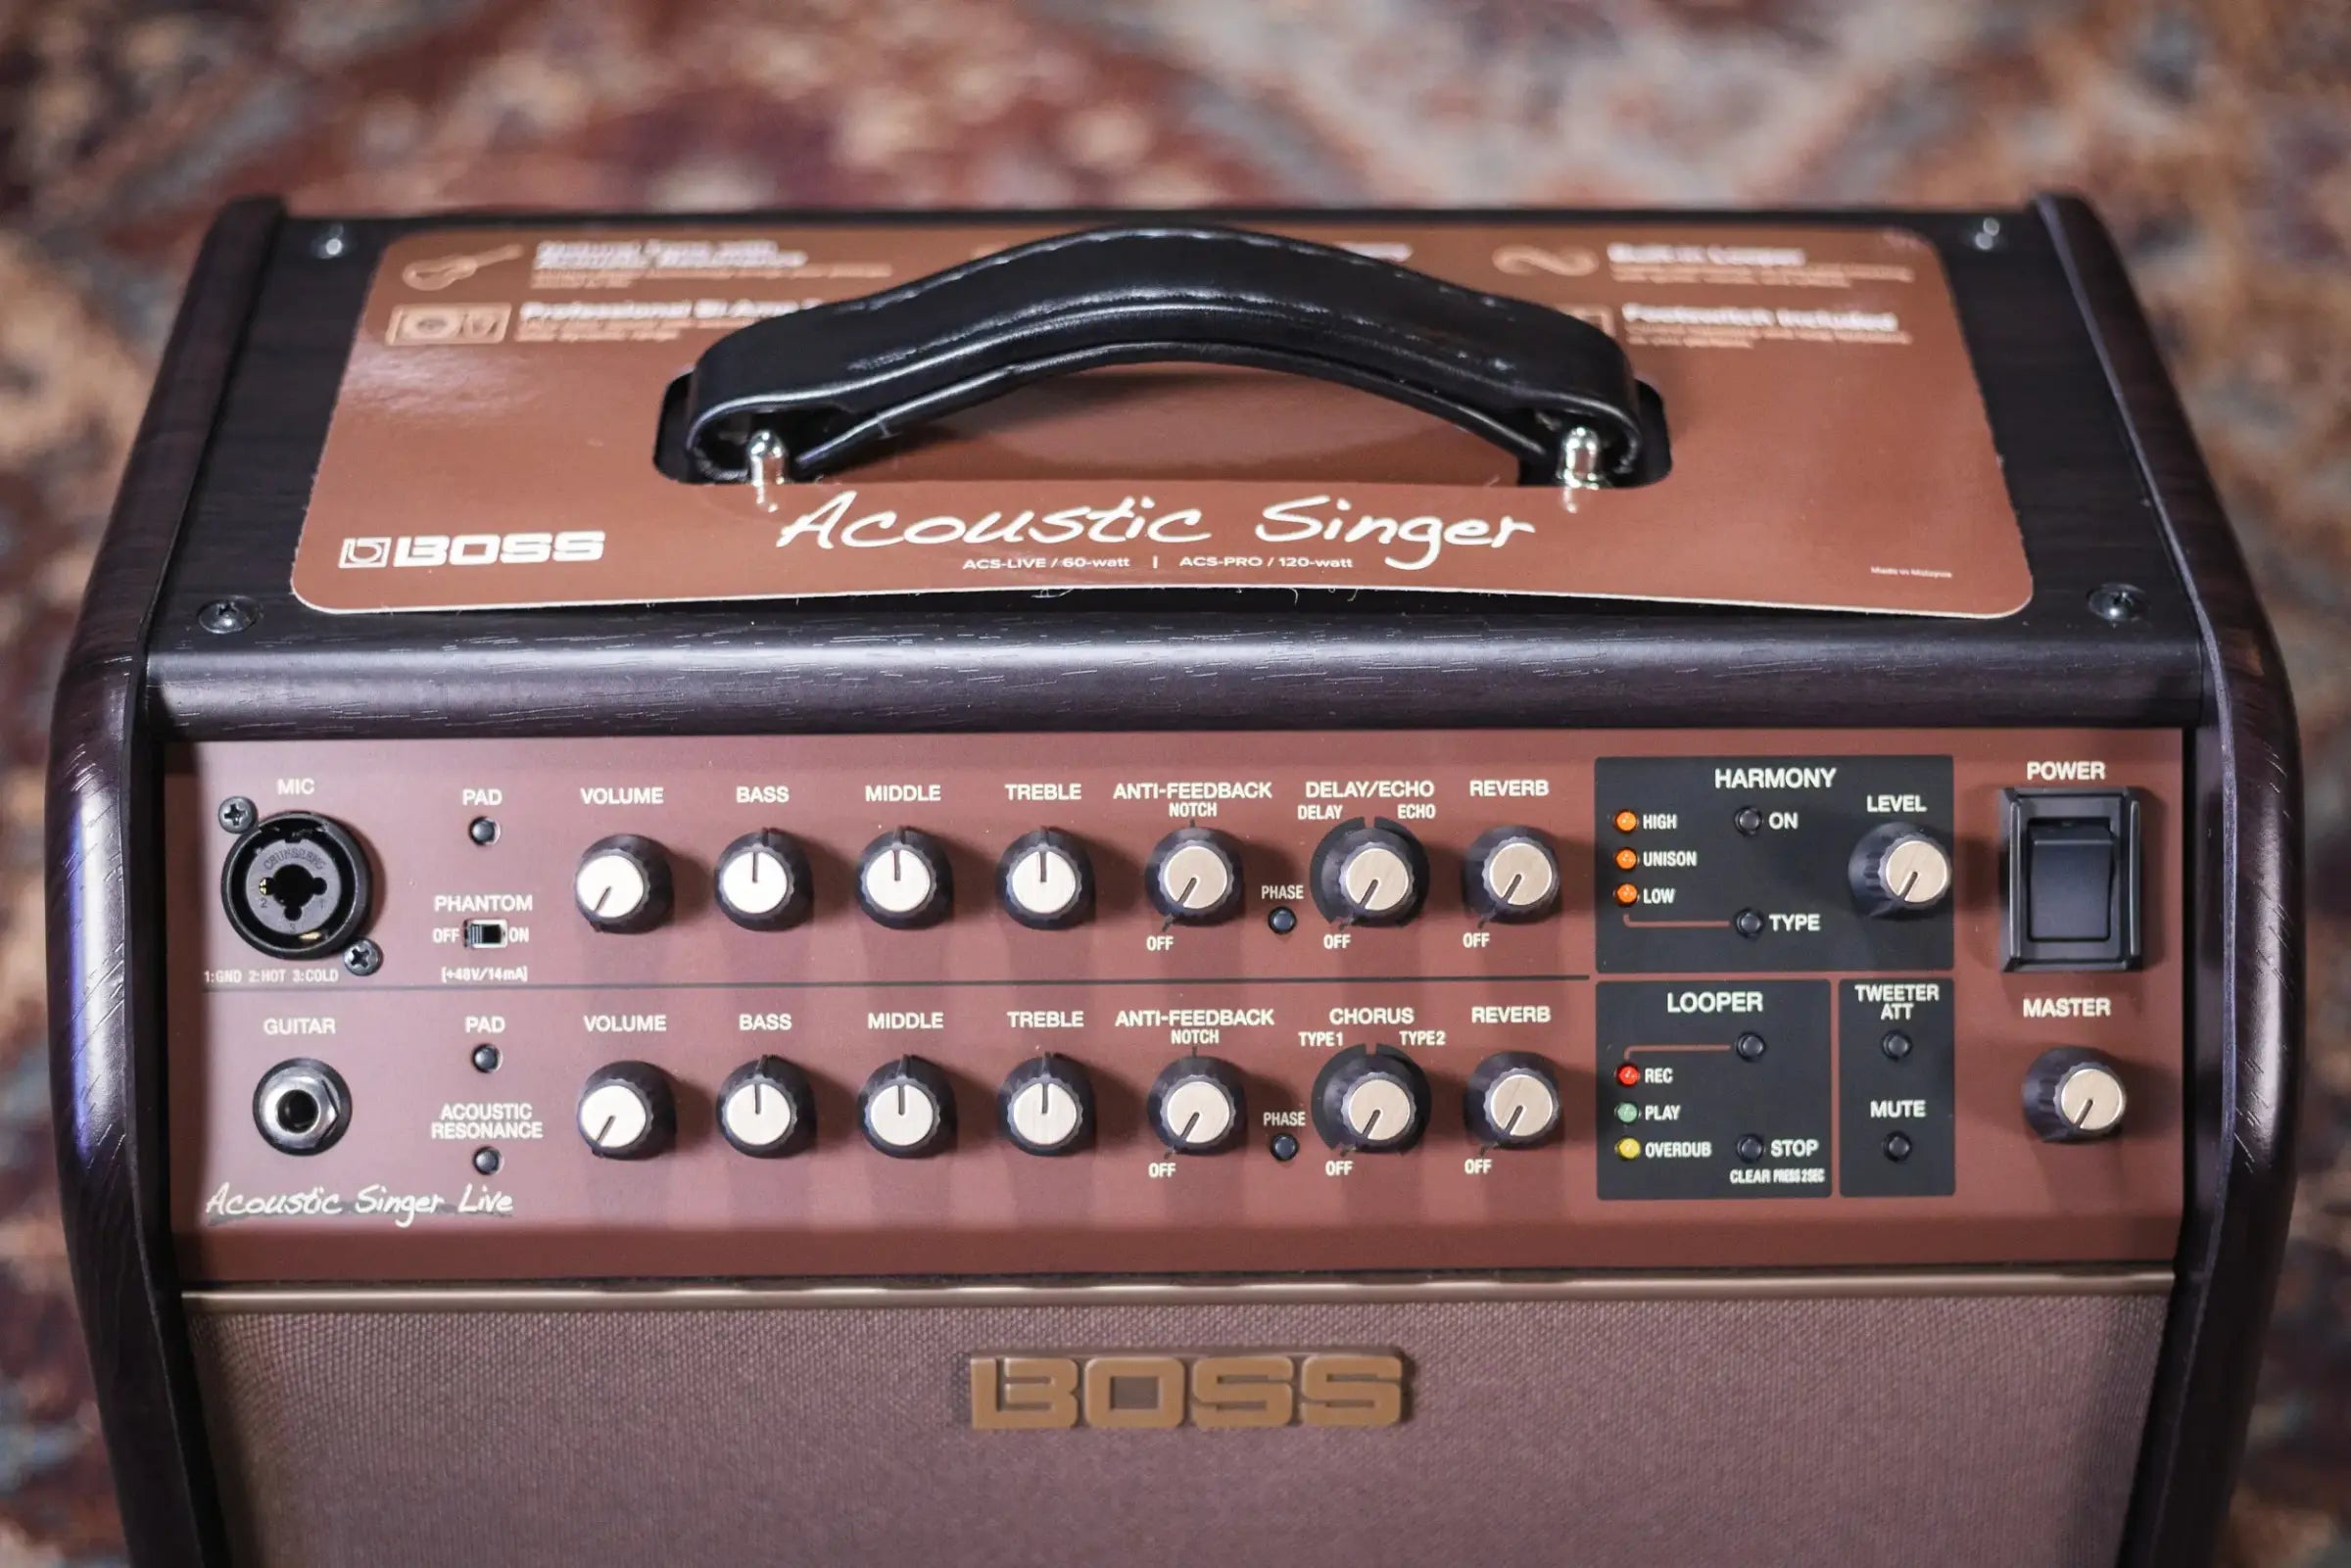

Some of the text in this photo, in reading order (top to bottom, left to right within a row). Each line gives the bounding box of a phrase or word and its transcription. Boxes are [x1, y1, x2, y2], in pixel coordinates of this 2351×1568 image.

[777, 490, 1535, 571] Acoustic Singer
[393, 530, 606, 568] BOSS
[962, 556, 1047, 570] ACS-LIVE
[1060, 556, 1130, 568] 60-watt
[1178, 555, 1264, 567] ACS-PRO
[1278, 556, 1354, 568] 120-watt
[1714, 767, 1837, 789] HARMONY
[2026, 761, 2106, 781] POWER
[276, 778, 315, 795] MIC
[579, 786, 664, 805] VOLUME
[736, 785, 790, 804] BASS
[865, 784, 941, 802] MIDDLE
[1004, 783, 1082, 801] TREBLE
[1112, 782, 1272, 800] ANTI-FEEDBACK
[1305, 780, 1435, 798] DELAY/ECHO
[1469, 779, 1550, 797] REVERB
[462, 788, 504, 806] PAD
[1866, 794, 1928, 813] LEVEL
[1169, 801, 1218, 818] NOTCH
[1297, 803, 1436, 821] DELAY ECHO
[1643, 813, 1678, 831] HIGH
[1768, 811, 1799, 830] ON
[1643, 850, 1698, 867] UNISON
[1261, 883, 1305, 900] PHASE
[1643, 887, 1676, 904] LOW
[434, 894, 533, 913] PHANTOM
[1768, 913, 1821, 931] TYPE
[432, 927, 460, 944] OFF
[507, 927, 530, 943] ON
[1146, 935, 1175, 952] OFF
[1322, 933, 1351, 950] OFF
[1463, 931, 1490, 949] OFF
[204, 968, 339, 983] 1:GND 2:HOT 3:COLD
[1854, 983, 1940, 1002] TWEETER
[1666, 991, 1763, 1014] LOOPER
[1880, 1002, 1914, 1021] ATT
[2023, 997, 2111, 1018] MASTER
[583, 1014, 667, 1032] VOLUME
[739, 1013, 792, 1031] BASS
[867, 1012, 944, 1029] MIDDLE
[1006, 1010, 1084, 1028] TREBLE
[1114, 1008, 1275, 1027] ANTI-FEEDBACK
[1328, 1007, 1415, 1025] CHORUS
[1471, 1005, 1552, 1023] REVERB
[263, 1017, 336, 1035] GUITAR
[464, 1016, 505, 1033] PAD
[1171, 1028, 1220, 1045] NOTCH
[1297, 1029, 1446, 1047] TYPE1 TYPE2
[1644, 1067, 1673, 1084] REC
[440, 1103, 533, 1121] ACOUSTIC
[1645, 1104, 1681, 1121] PLAY
[1870, 1099, 1926, 1118] MUTE
[1263, 1111, 1307, 1127] PHASE
[431, 1120, 544, 1140] RESONANCE
[1645, 1141, 1712, 1159] OVERDUB
[1770, 1138, 1819, 1158] STOP
[1148, 1162, 1176, 1178] OFF
[1324, 1160, 1354, 1176] OFF
[1463, 1158, 1492, 1175] OFF
[1729, 1168, 1771, 1184] CLEAR
[206, 1181, 513, 1228] Acoustic Singer Live
[970, 1354, 1403, 1430] BOSS
